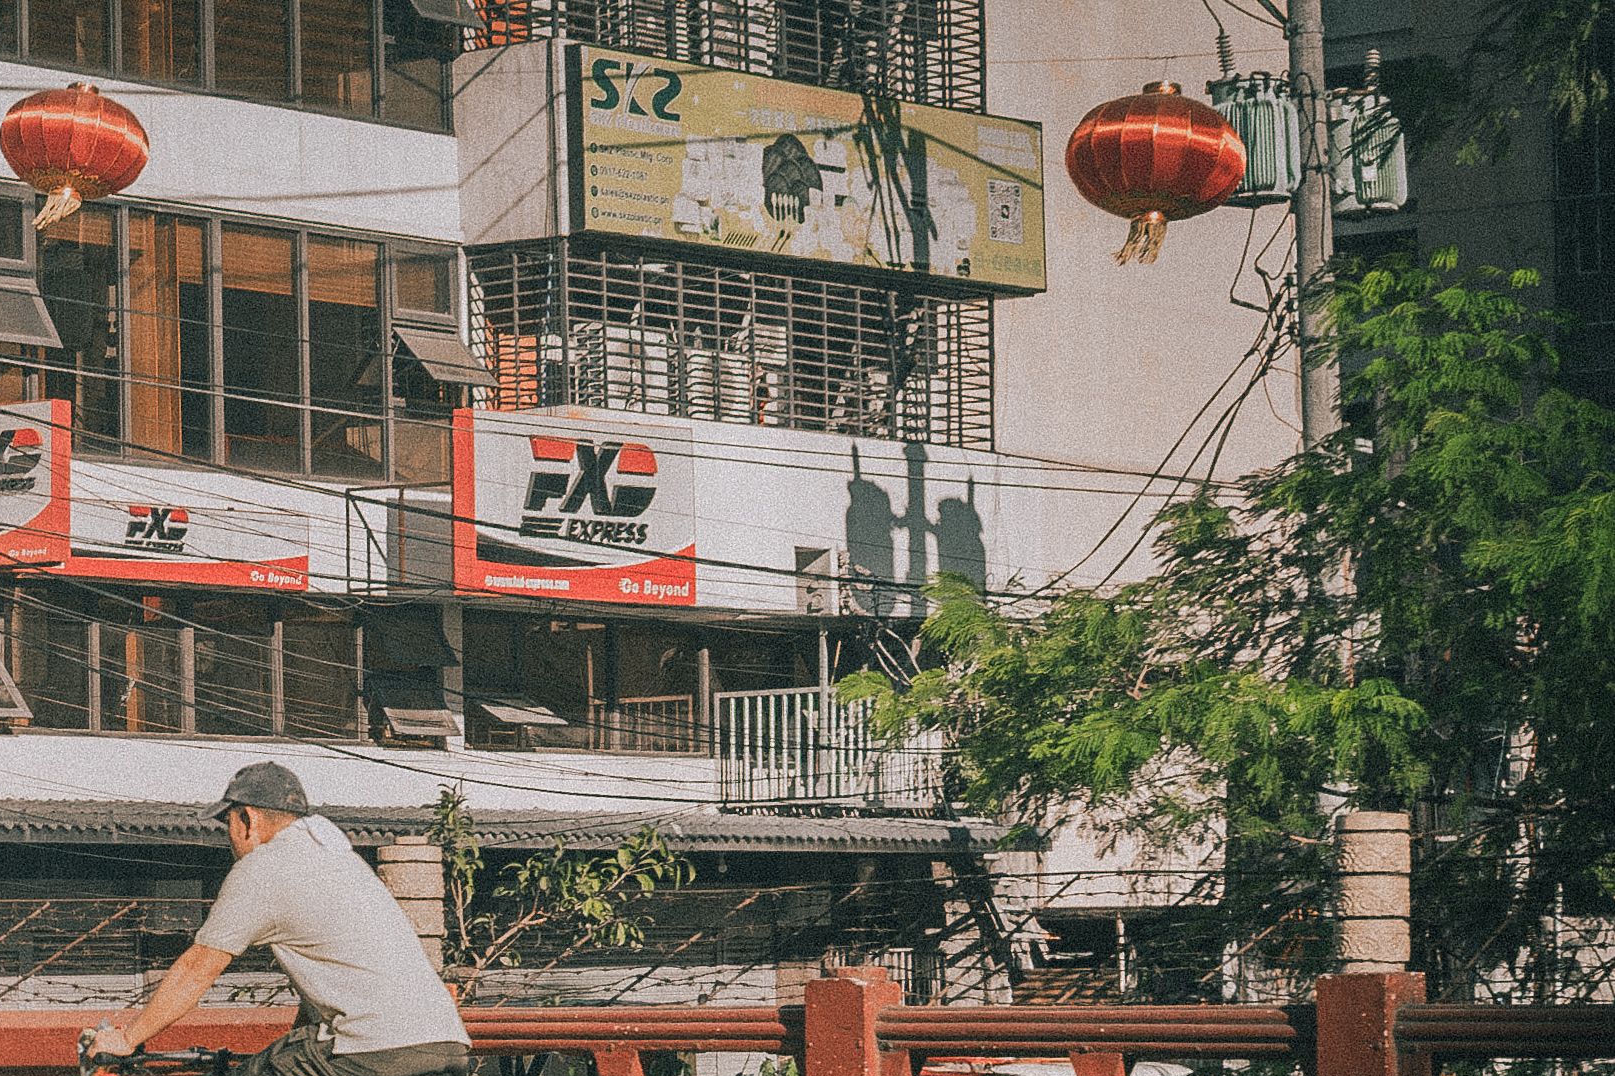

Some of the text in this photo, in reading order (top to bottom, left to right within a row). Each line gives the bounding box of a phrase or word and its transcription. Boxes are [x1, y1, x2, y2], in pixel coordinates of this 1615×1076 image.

[566, 518, 649, 545] EXPRESS
[268, 571, 303, 586] Beyond
[621, 577, 640, 594] Go
[643, 579, 690, 599] Beyond
